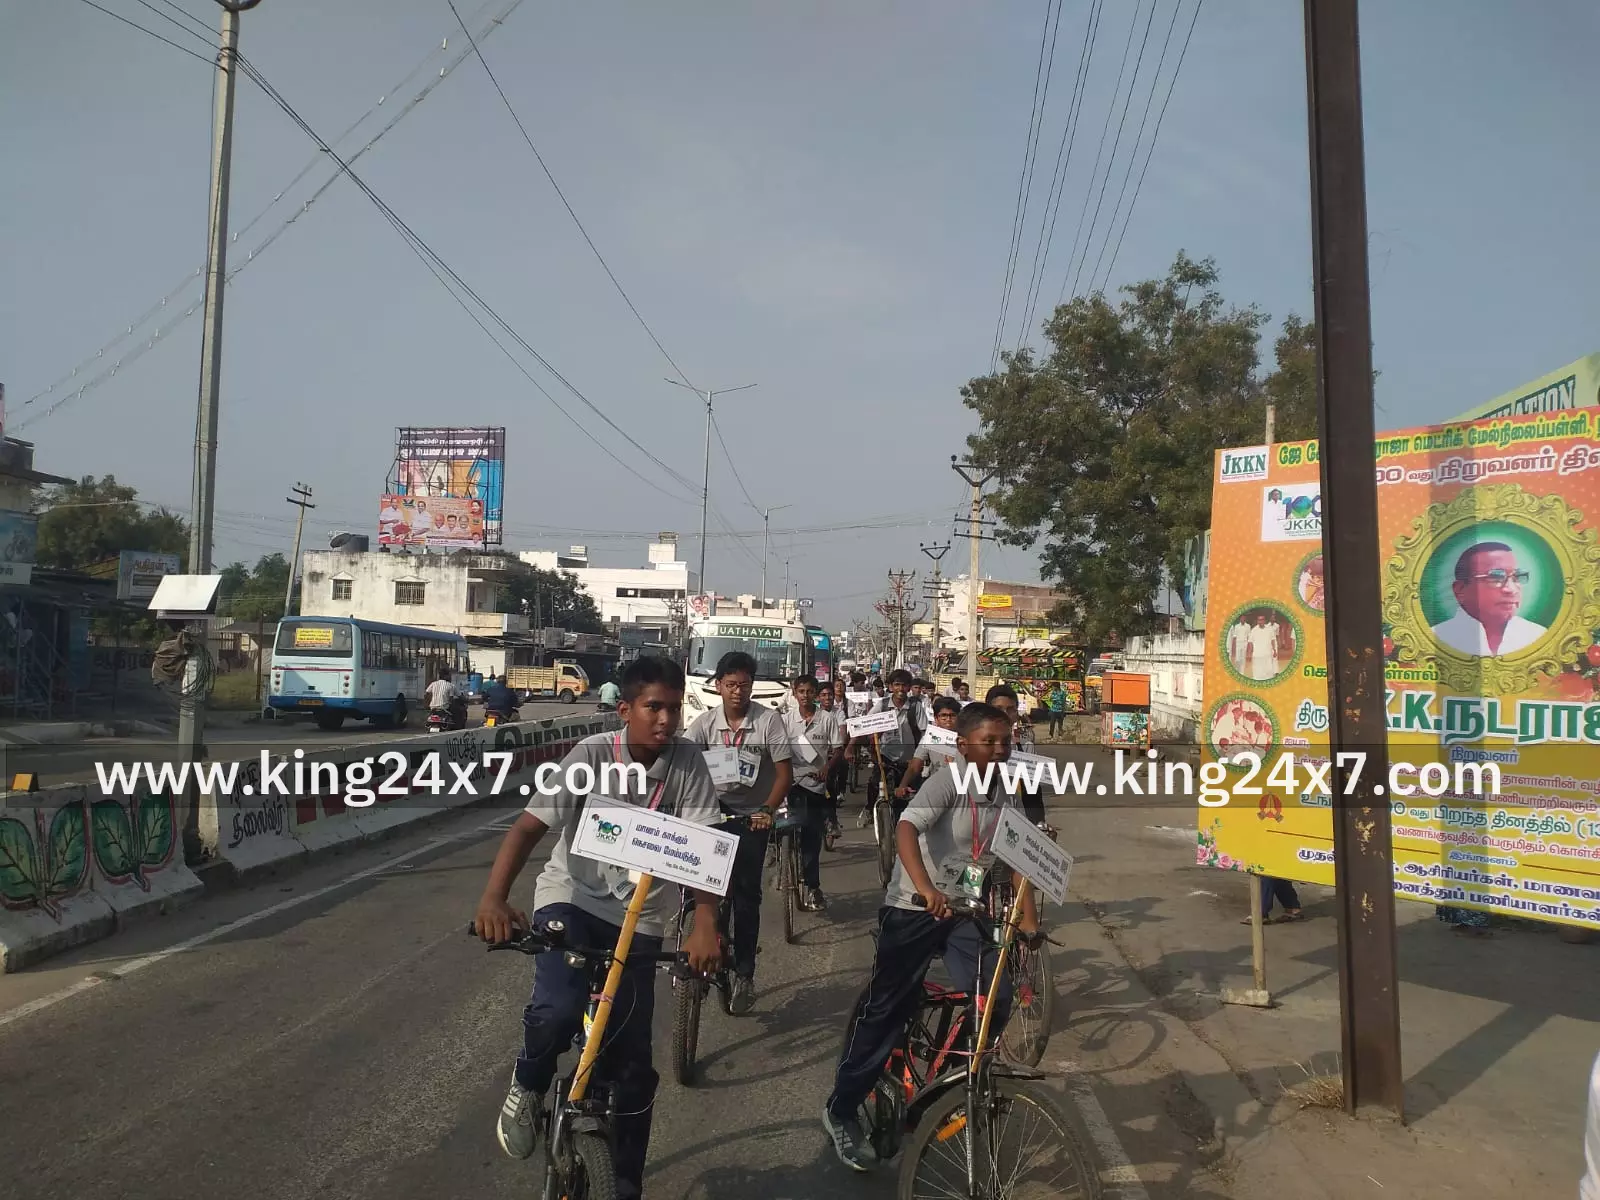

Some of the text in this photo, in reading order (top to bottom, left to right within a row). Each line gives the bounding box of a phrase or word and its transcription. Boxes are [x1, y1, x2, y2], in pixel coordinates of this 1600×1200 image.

[1222, 454, 1266, 475] JKKN
[1438, 447, 1556, 482] நிறுவனர்
[1451, 746, 1520, 764] நிறுவனர்
[1434, 804, 1488, 828] பிறந்த
[1490, 810, 1572, 835] தினத்தில்
[1481, 835, 1546, 854] பெருமிதம்
